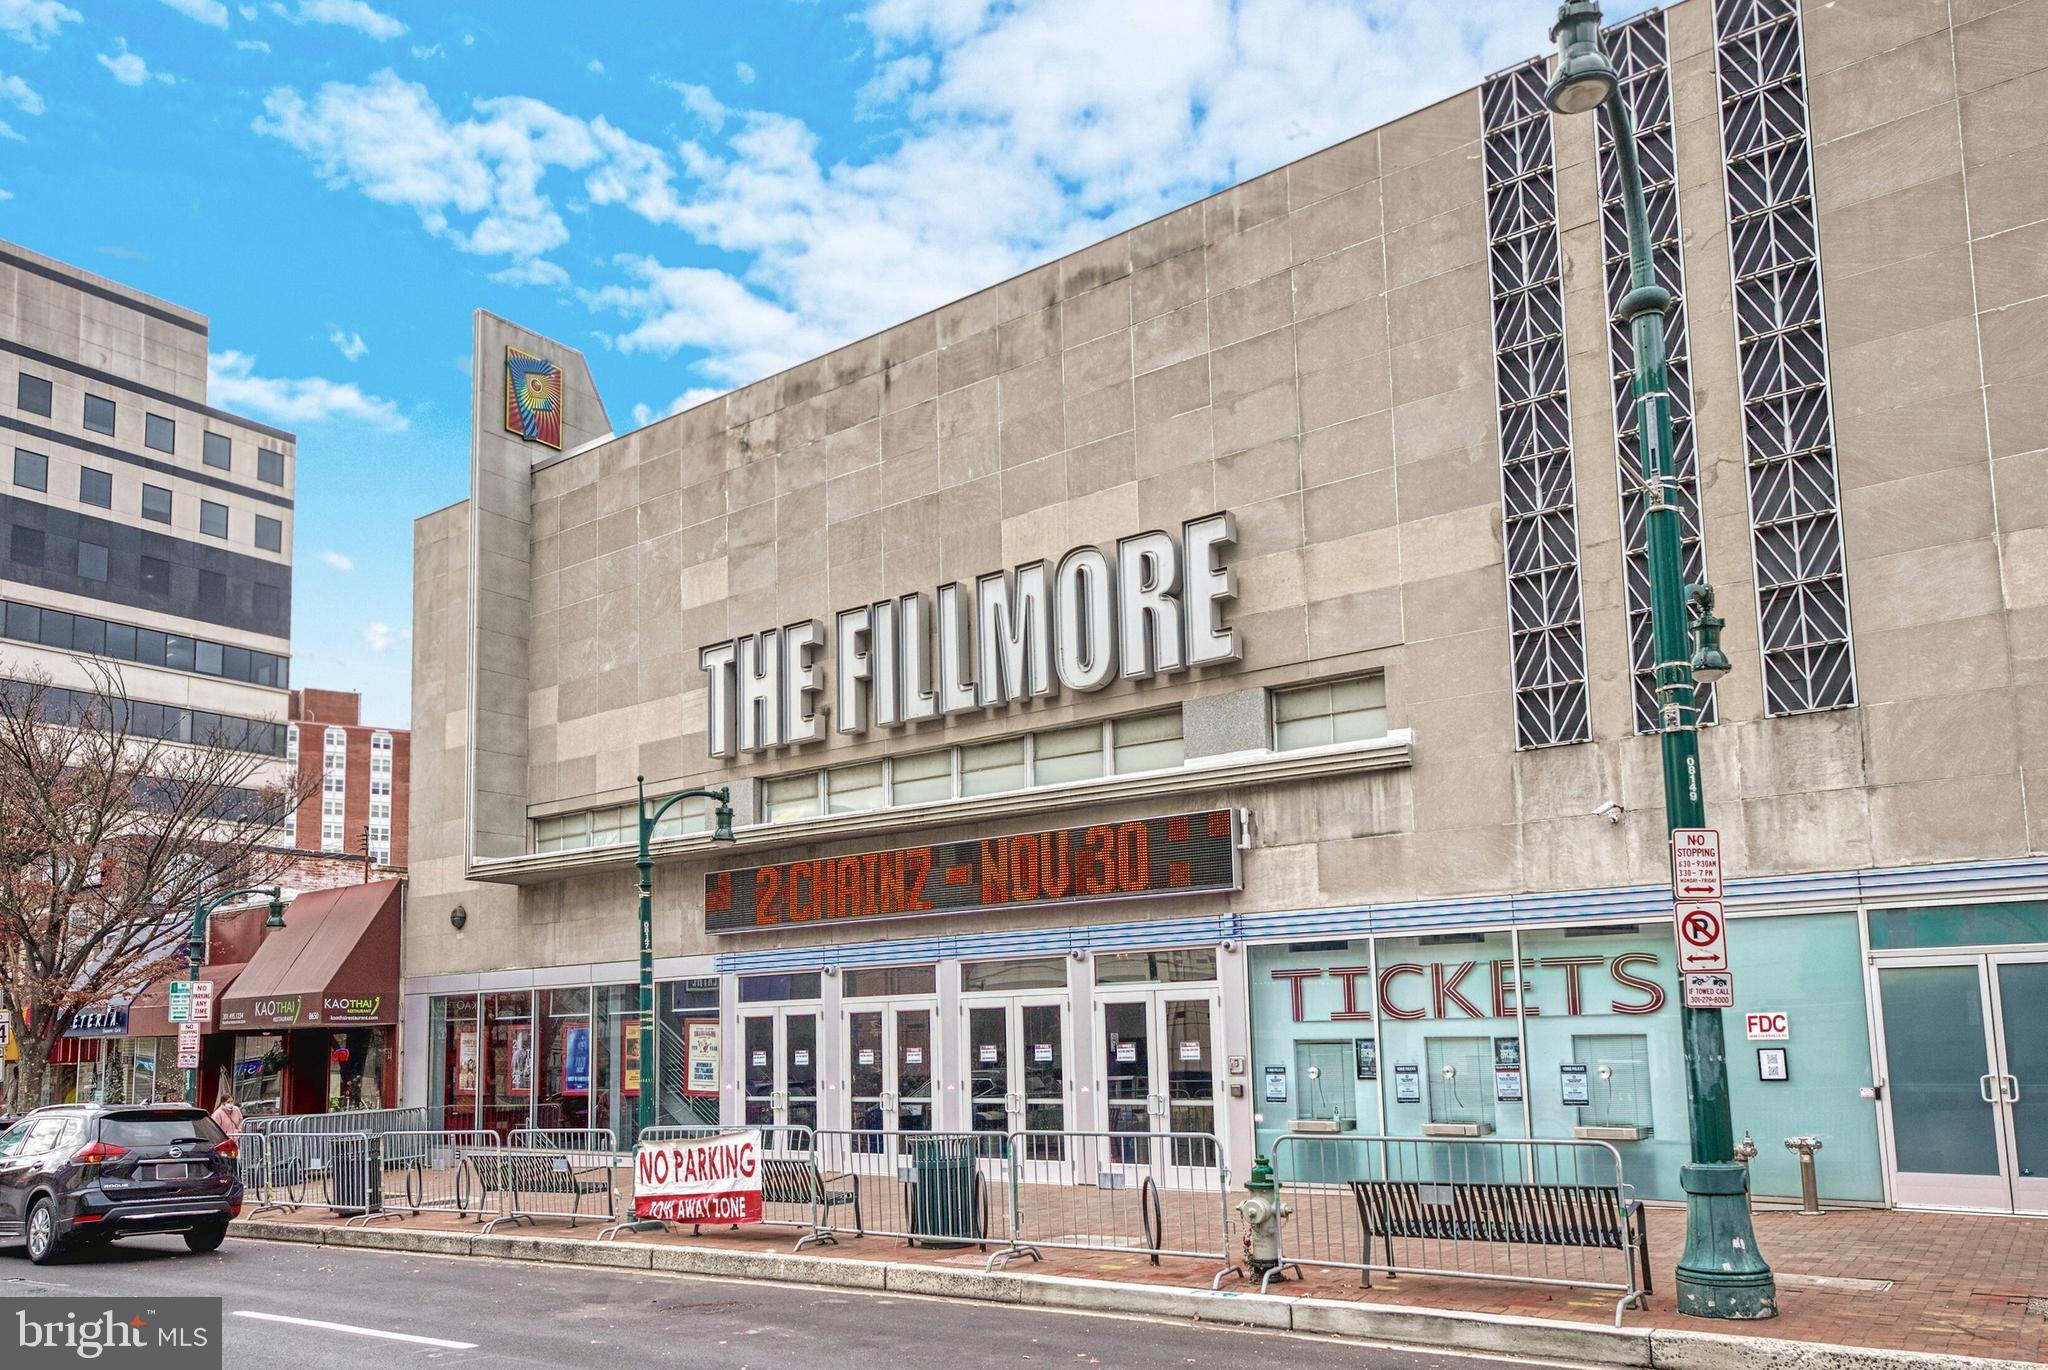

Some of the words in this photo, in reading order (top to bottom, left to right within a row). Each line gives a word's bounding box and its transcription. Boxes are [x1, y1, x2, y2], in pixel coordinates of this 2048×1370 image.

[700, 618, 825, 759] THE
[836, 510, 1243, 734] FILLMORE
[1677, 848, 1716, 857] STOPPING
[1687, 834, 1705, 846] NO
[755, 865, 779, 925] 2
[789, 847, 932, 922] CHAINZ
[980, 830, 1070, 905] NOV
[1084, 820, 1150, 895] 30
[1271, 952, 1665, 1023] TICKETS
[1748, 1015, 1786, 1033] FDC
[640, 1150, 669, 1184] NO
[673, 1143, 756, 1182] PARKING
[676, 1199, 711, 1218] AWAY
[712, 1197, 746, 1218] ZONE
